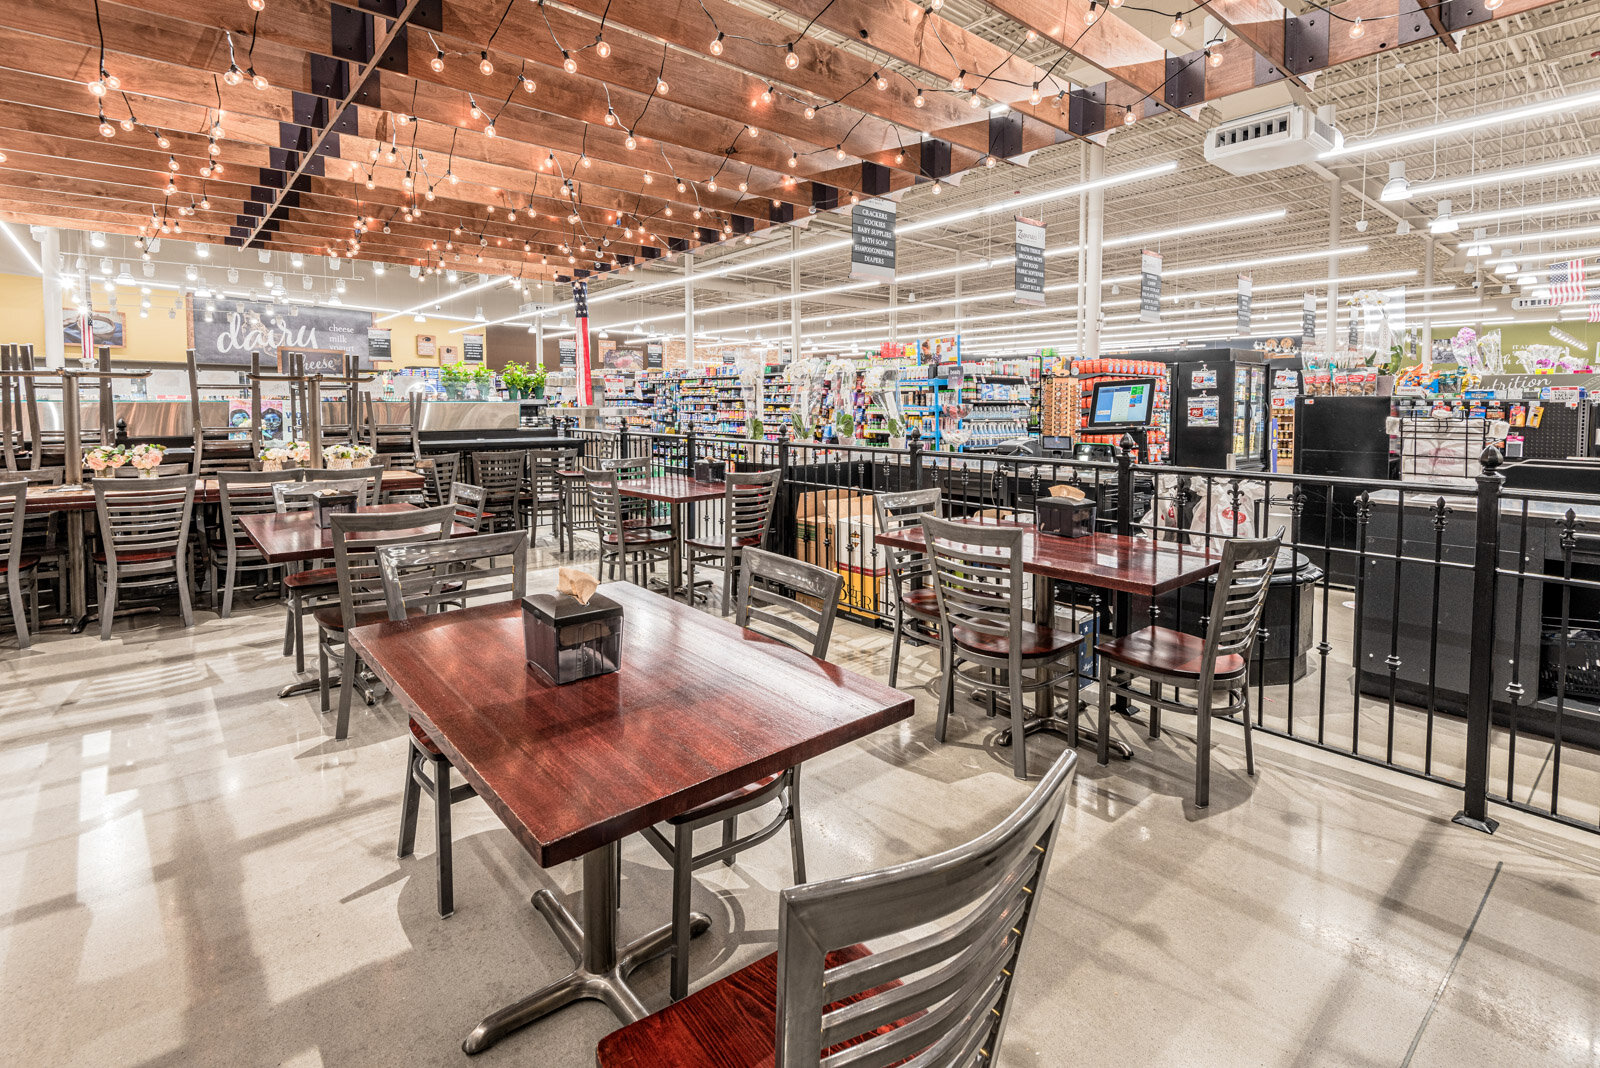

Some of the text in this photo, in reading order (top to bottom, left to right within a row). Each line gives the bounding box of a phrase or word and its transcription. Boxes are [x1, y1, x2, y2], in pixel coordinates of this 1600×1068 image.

[862, 209, 888, 220] CRACKERS
[863, 218, 886, 228] COOKIES
[857, 226, 892, 238] BABY SUPPLIES
[861, 236, 888, 247] BATH SOAP
[864, 255, 885, 265] DIAPERS
[328, 323, 355, 335] cheese
[329, 334, 348, 344] milk
[294, 354, 335, 371] heese
